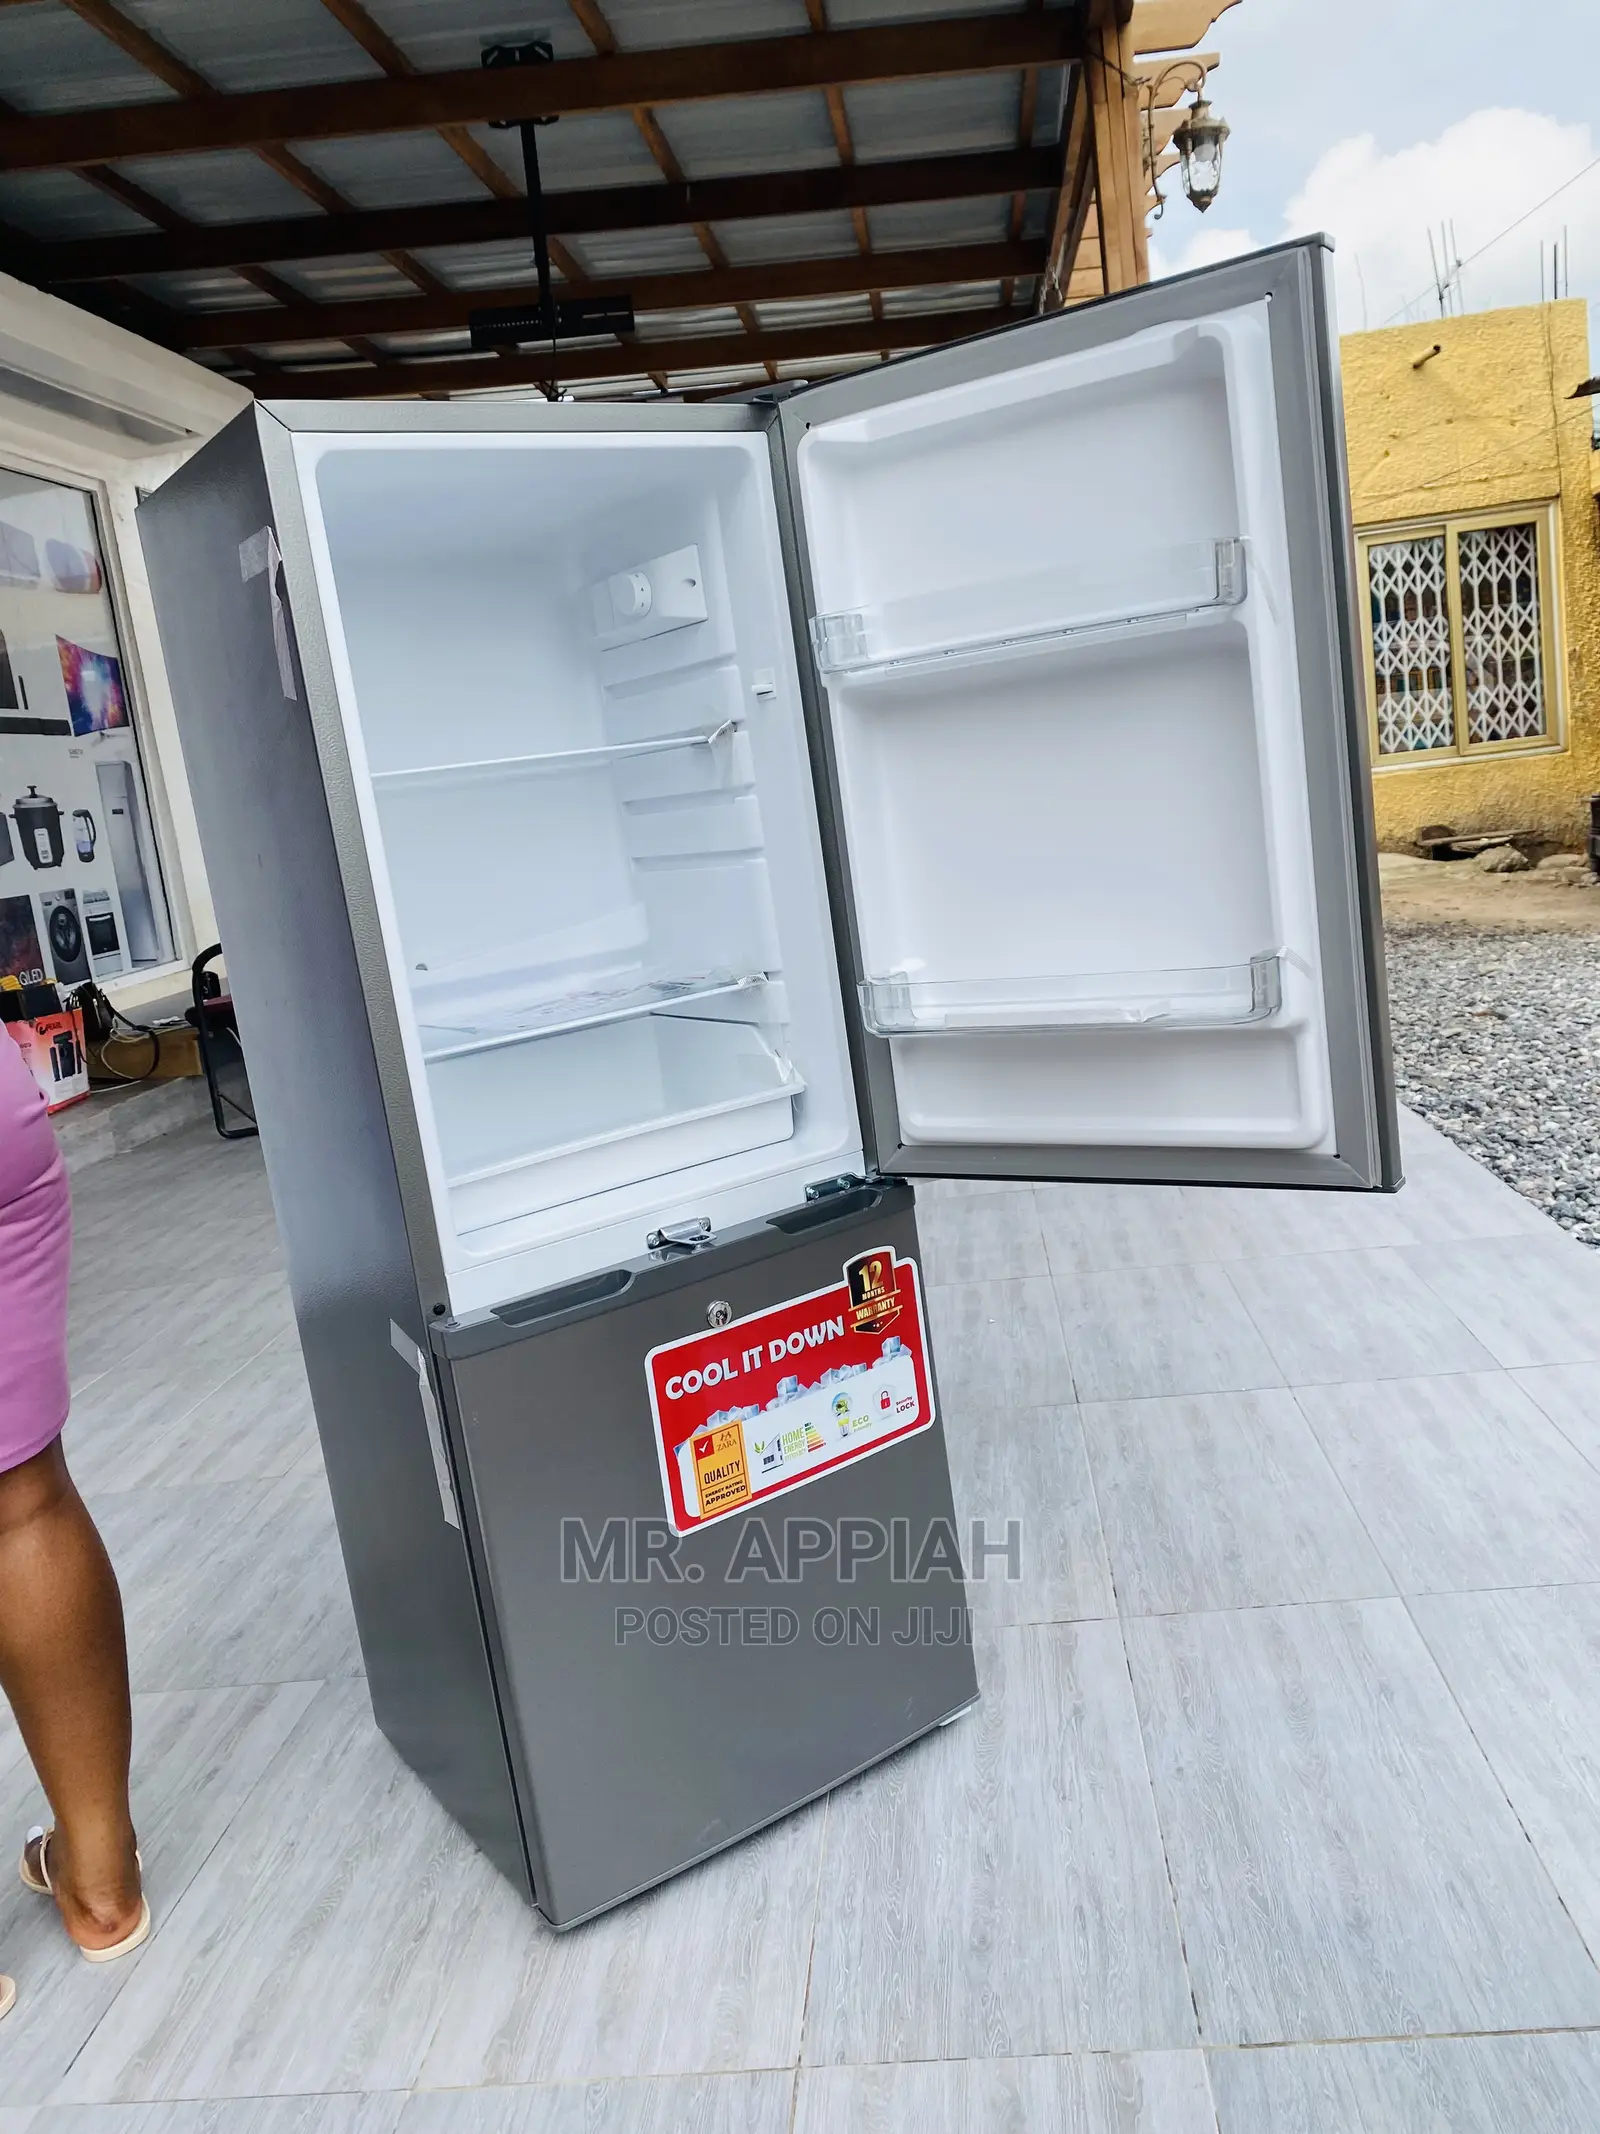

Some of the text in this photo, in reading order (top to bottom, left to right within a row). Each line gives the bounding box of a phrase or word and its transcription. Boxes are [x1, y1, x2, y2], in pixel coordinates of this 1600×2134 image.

[858, 1261, 884, 1292] 12
[861, 1286, 885, 1301] MONTHS
[855, 1297, 895, 1321] WARRANTY
[665, 1315, 845, 1401] COOL IT DOWN
[896, 1400, 915, 1413] LOCK
[852, 1415, 869, 1427] ECO
[717, 1438, 737, 1451] ZARA
[782, 1427, 804, 1446] HOME
[784, 1439, 806, 1455] ENERGY
[704, 1460, 740, 1485] QUALITY
[705, 1479, 743, 1498] ENERGY RATING
[705, 1485, 746, 1507] APPROVED
